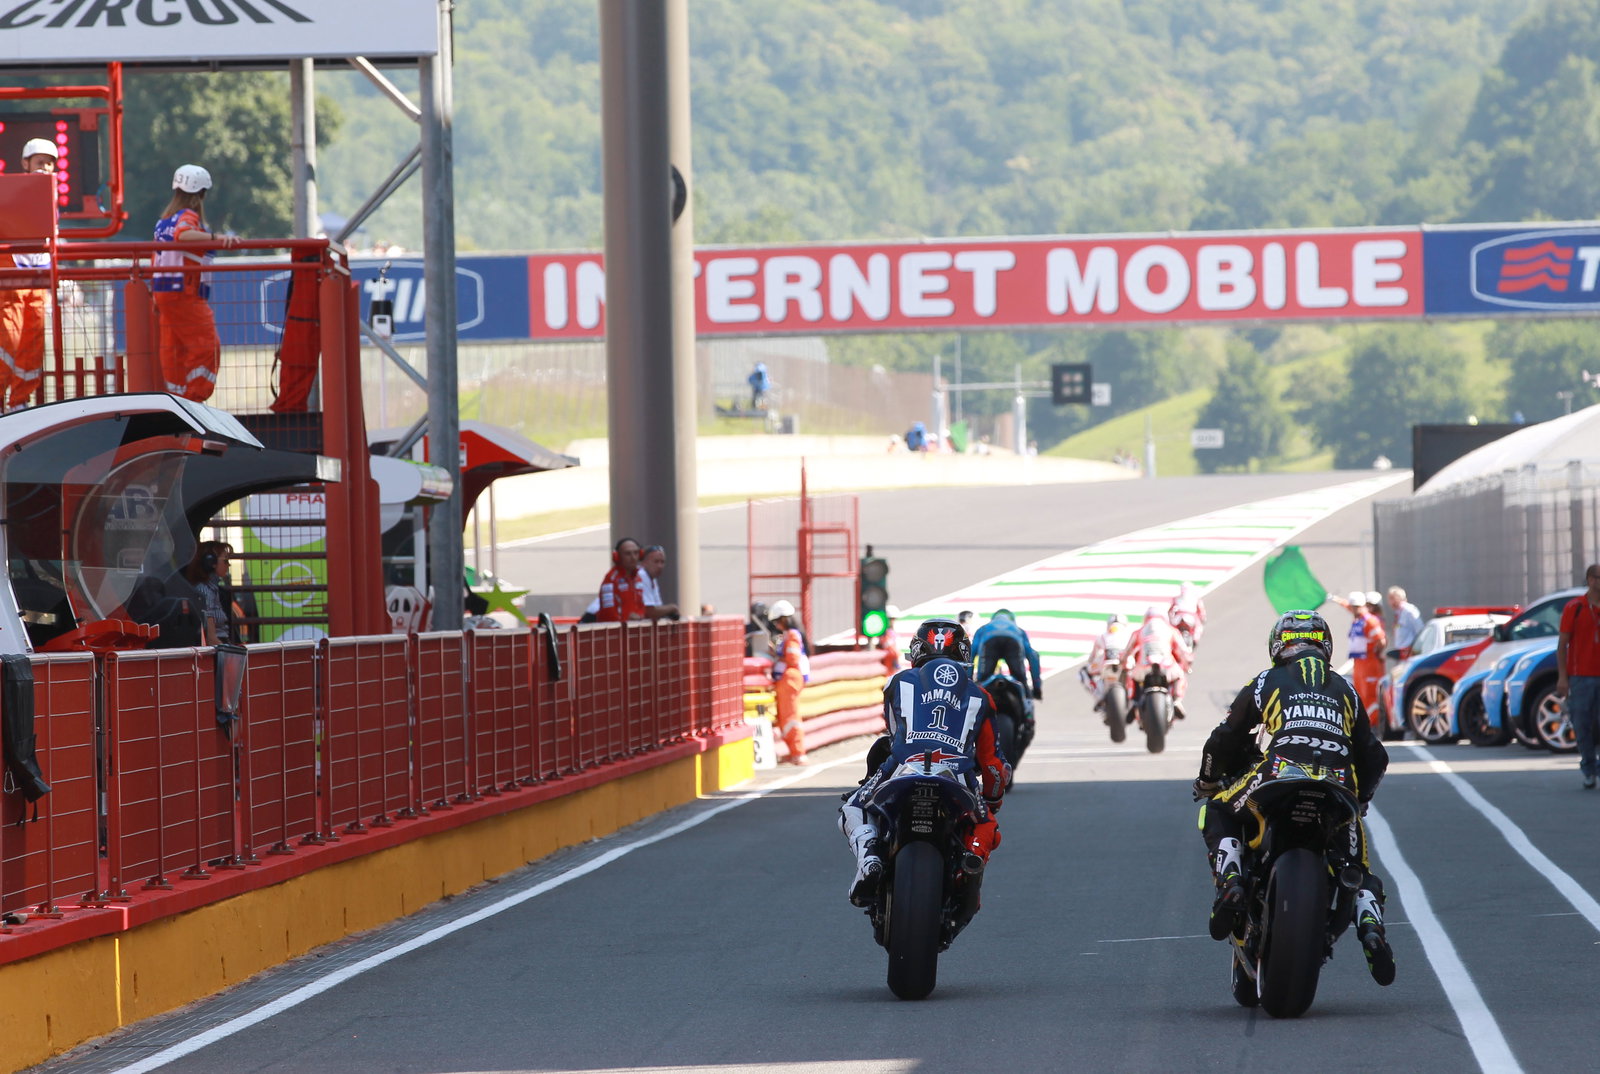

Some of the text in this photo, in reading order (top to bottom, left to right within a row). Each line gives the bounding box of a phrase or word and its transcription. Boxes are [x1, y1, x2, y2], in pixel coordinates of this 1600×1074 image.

[1046, 240, 1409, 315] MOBILE
[921, 688, 961, 710] YAMAHA
[927, 705, 949, 731] 1
[1283, 705, 1344, 728] YAMAHA
[1274, 735, 1349, 757] SPIDI
